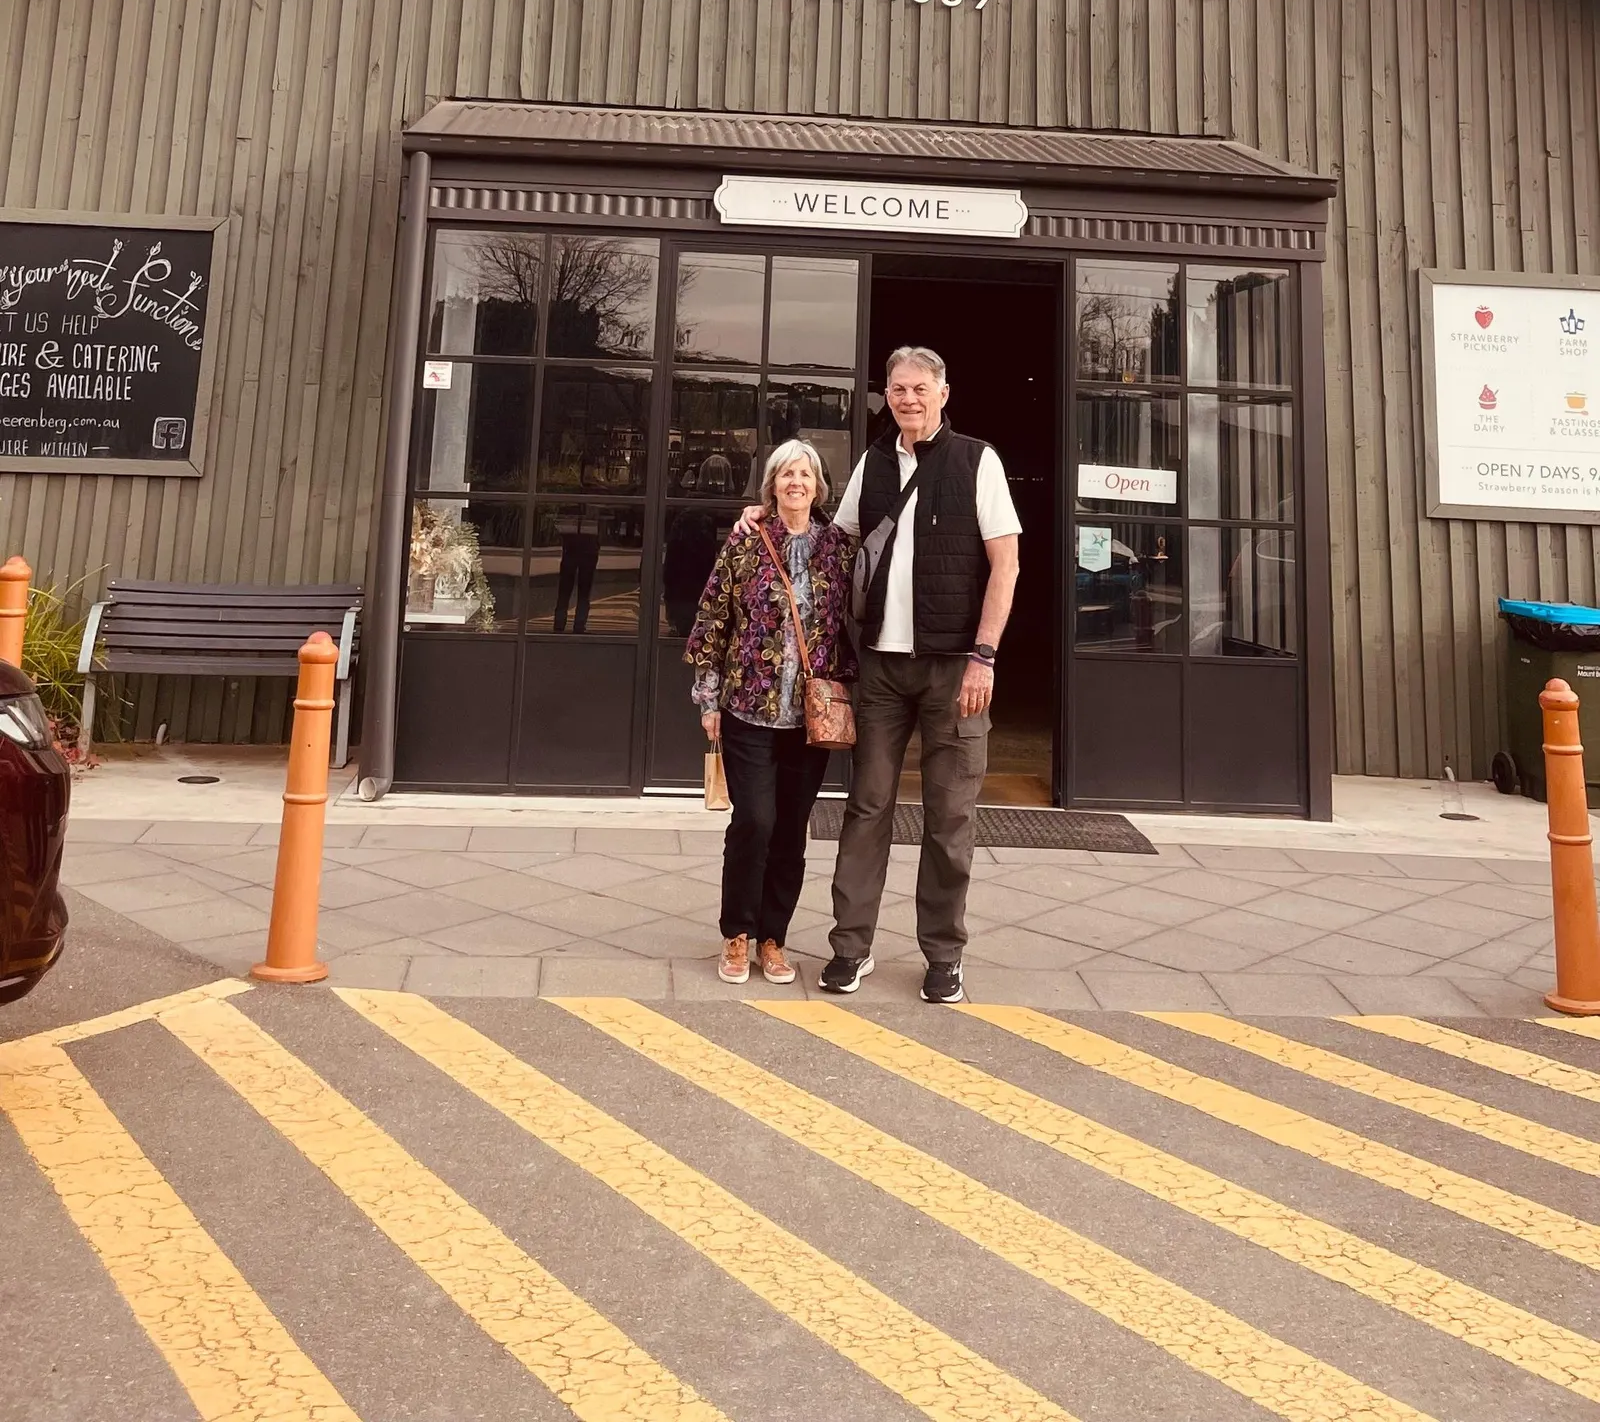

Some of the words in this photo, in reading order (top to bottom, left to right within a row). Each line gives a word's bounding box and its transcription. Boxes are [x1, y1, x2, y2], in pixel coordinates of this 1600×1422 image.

[794, 192, 950, 220] WELCOME
[4, 260, 68, 309] your
[66, 238, 118, 300] next
[24, 311, 49, 334] US
[61, 314, 99, 336] HELP
[1450, 332, 1520, 345] STRAWBERRY
[1463, 342, 1508, 353] PICKING
[1559, 338, 1588, 347] FARM
[0, 342, 28, 367] IRE
[35, 340, 65, 370] &
[72, 342, 161, 373] CATERING
[1559, 347, 1588, 357] SHOP
[0, 372, 31, 398] GES
[46, 373, 132, 401] AVAILABLE
[0, 408, 120, 434] eerenberg.com.au
[1478, 414, 1499, 423] THE
[1473, 423, 1505, 433] DAIRY
[40, 441, 88, 457] WITHIN
[1476, 462, 1521, 477] OPEN
[1526, 464, 1535, 478] 7
[1540, 465, 1584, 482] DAYS,
[1589, 467, 1600, 481] 9
[1104, 473, 1150, 494] Open
[1478, 482, 1537, 495] Strawberry
[1541, 484, 1579, 495] Season
[1582, 486, 1591, 495] is
